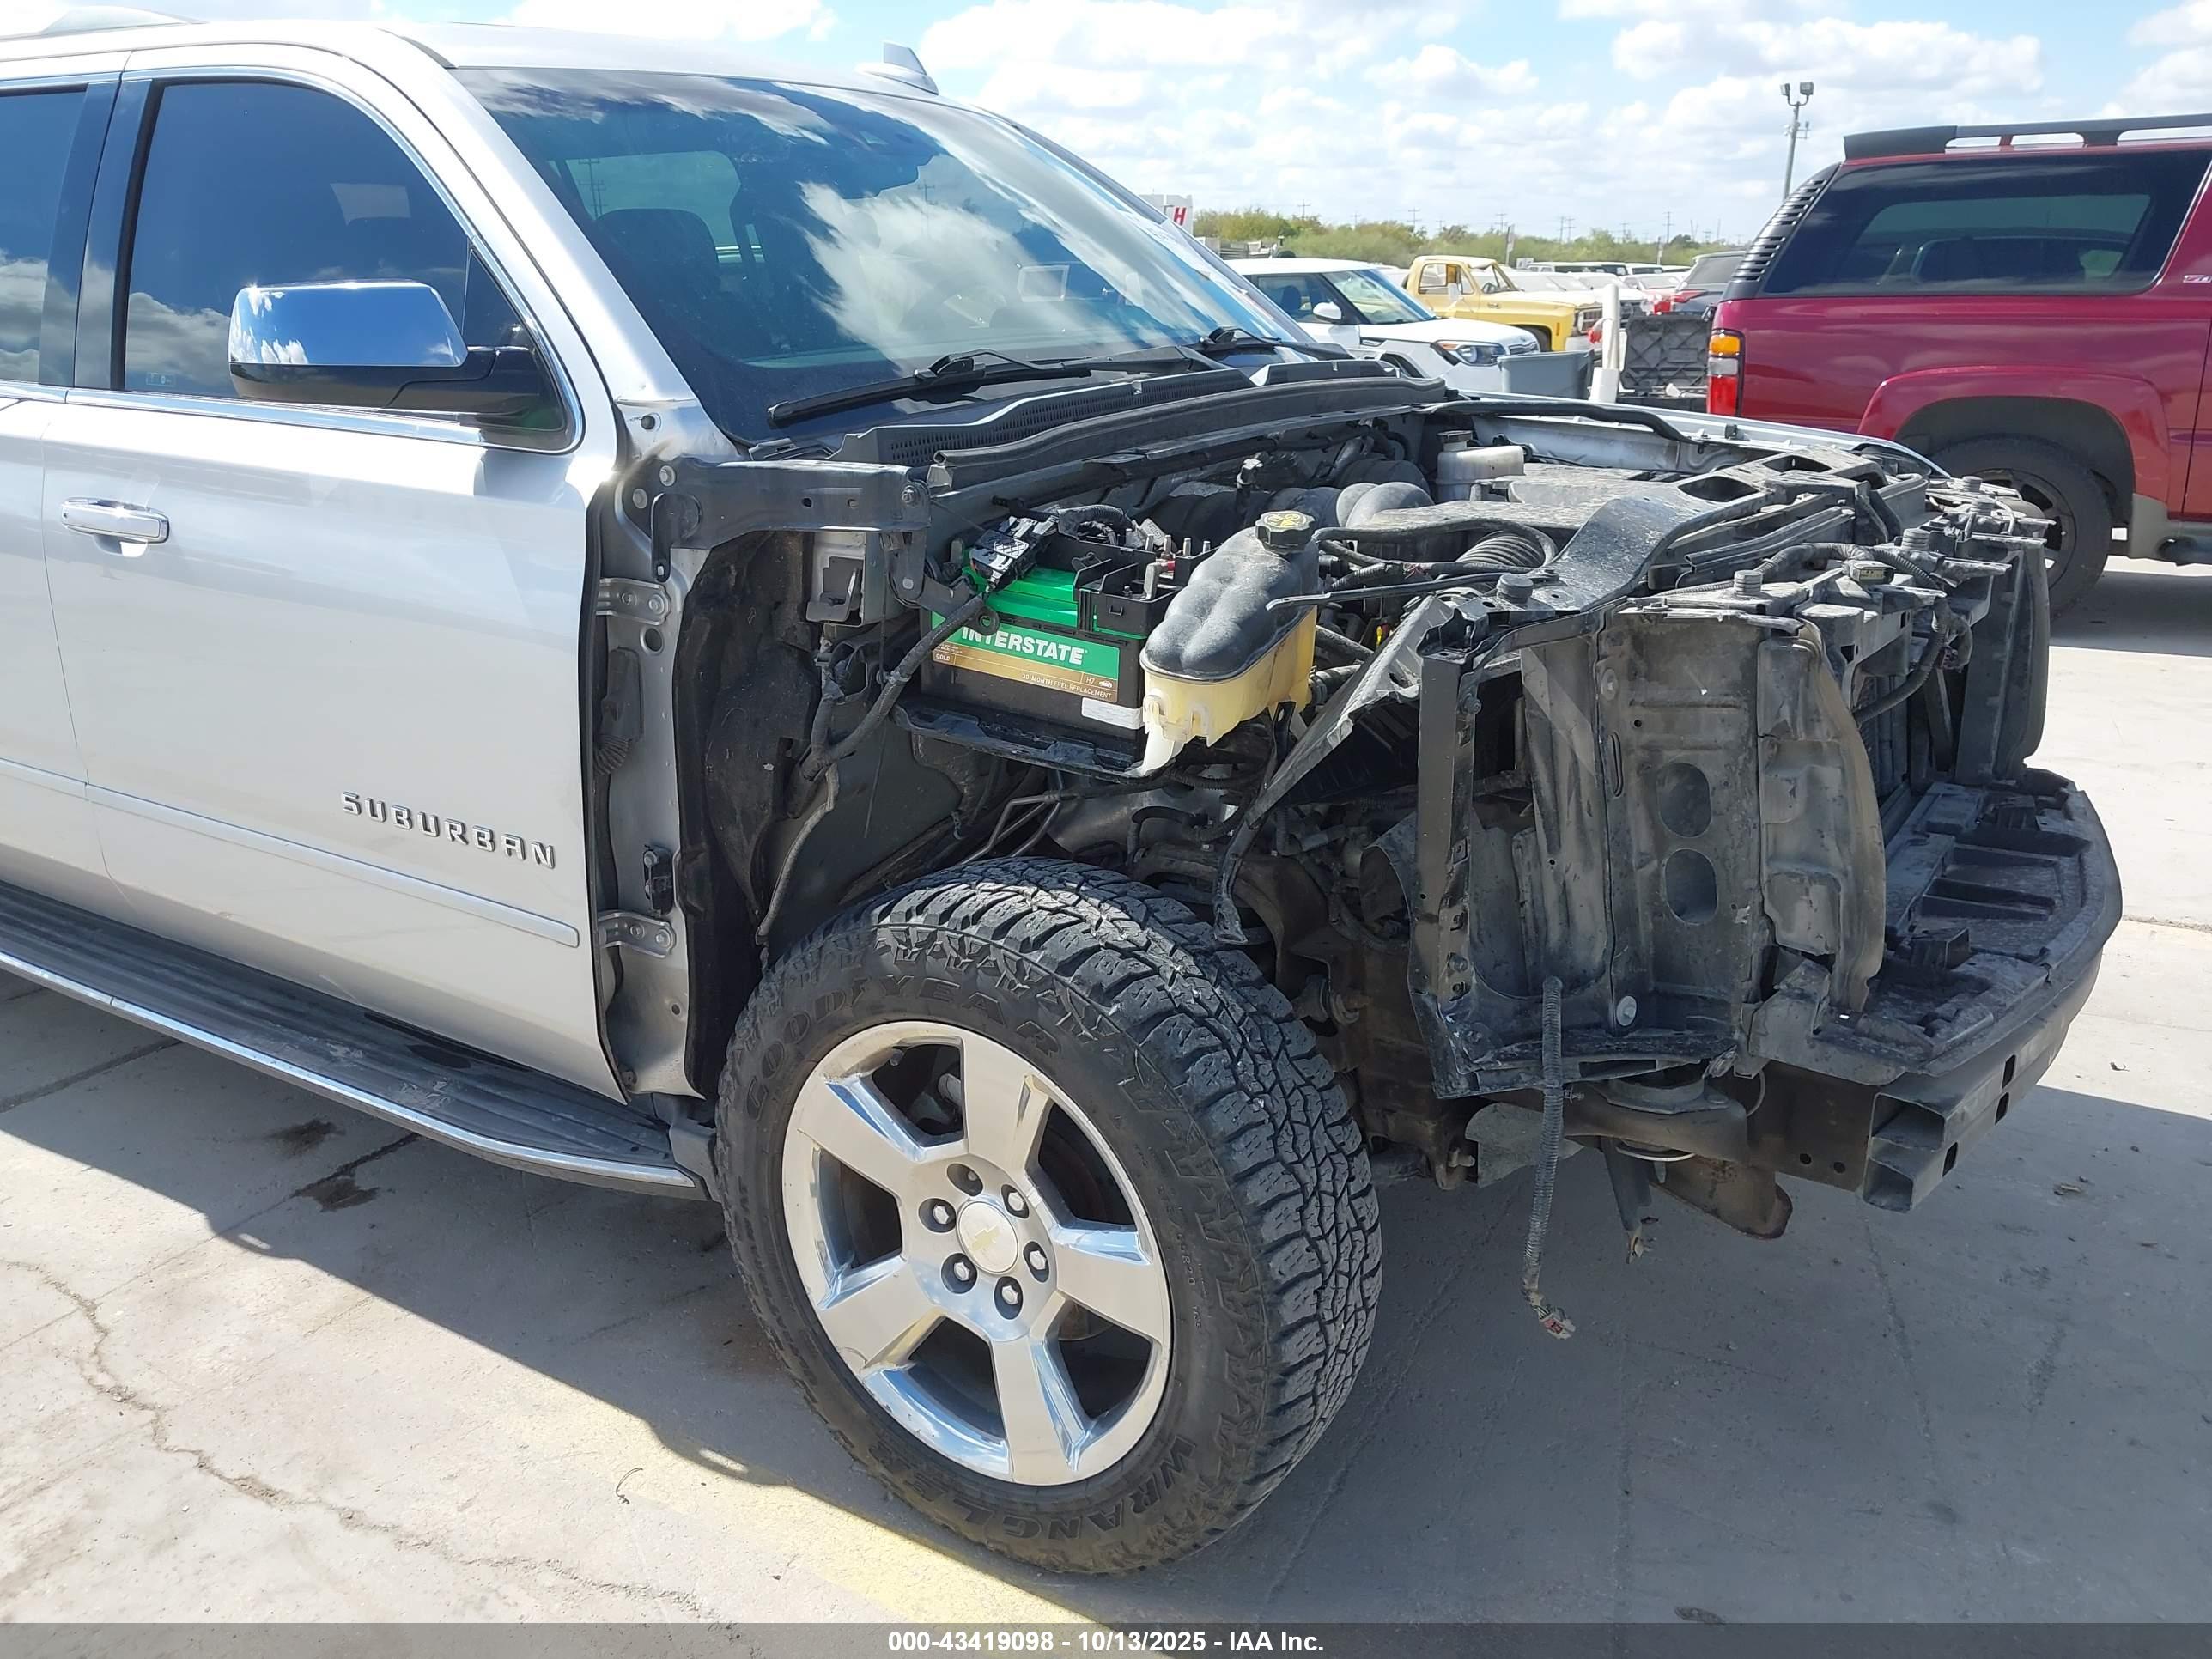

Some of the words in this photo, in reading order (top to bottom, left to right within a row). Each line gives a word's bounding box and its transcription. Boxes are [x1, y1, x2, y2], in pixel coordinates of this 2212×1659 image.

[935, 653, 951, 661] GOLD
[961, 626, 1085, 665] INTERSTATE
[1021, 672, 1054, 686] 30-MONTH
[1054, 680, 1069, 690] FREE
[1069, 683, 1113, 700] REPLACEMENT
[1085, 676, 1096, 684] H7
[341, 790, 556, 870] SUBURBAN
[745, 974, 1061, 1121] GOODYEAR
[867, 1434, 1198, 1540] WRANGLER
